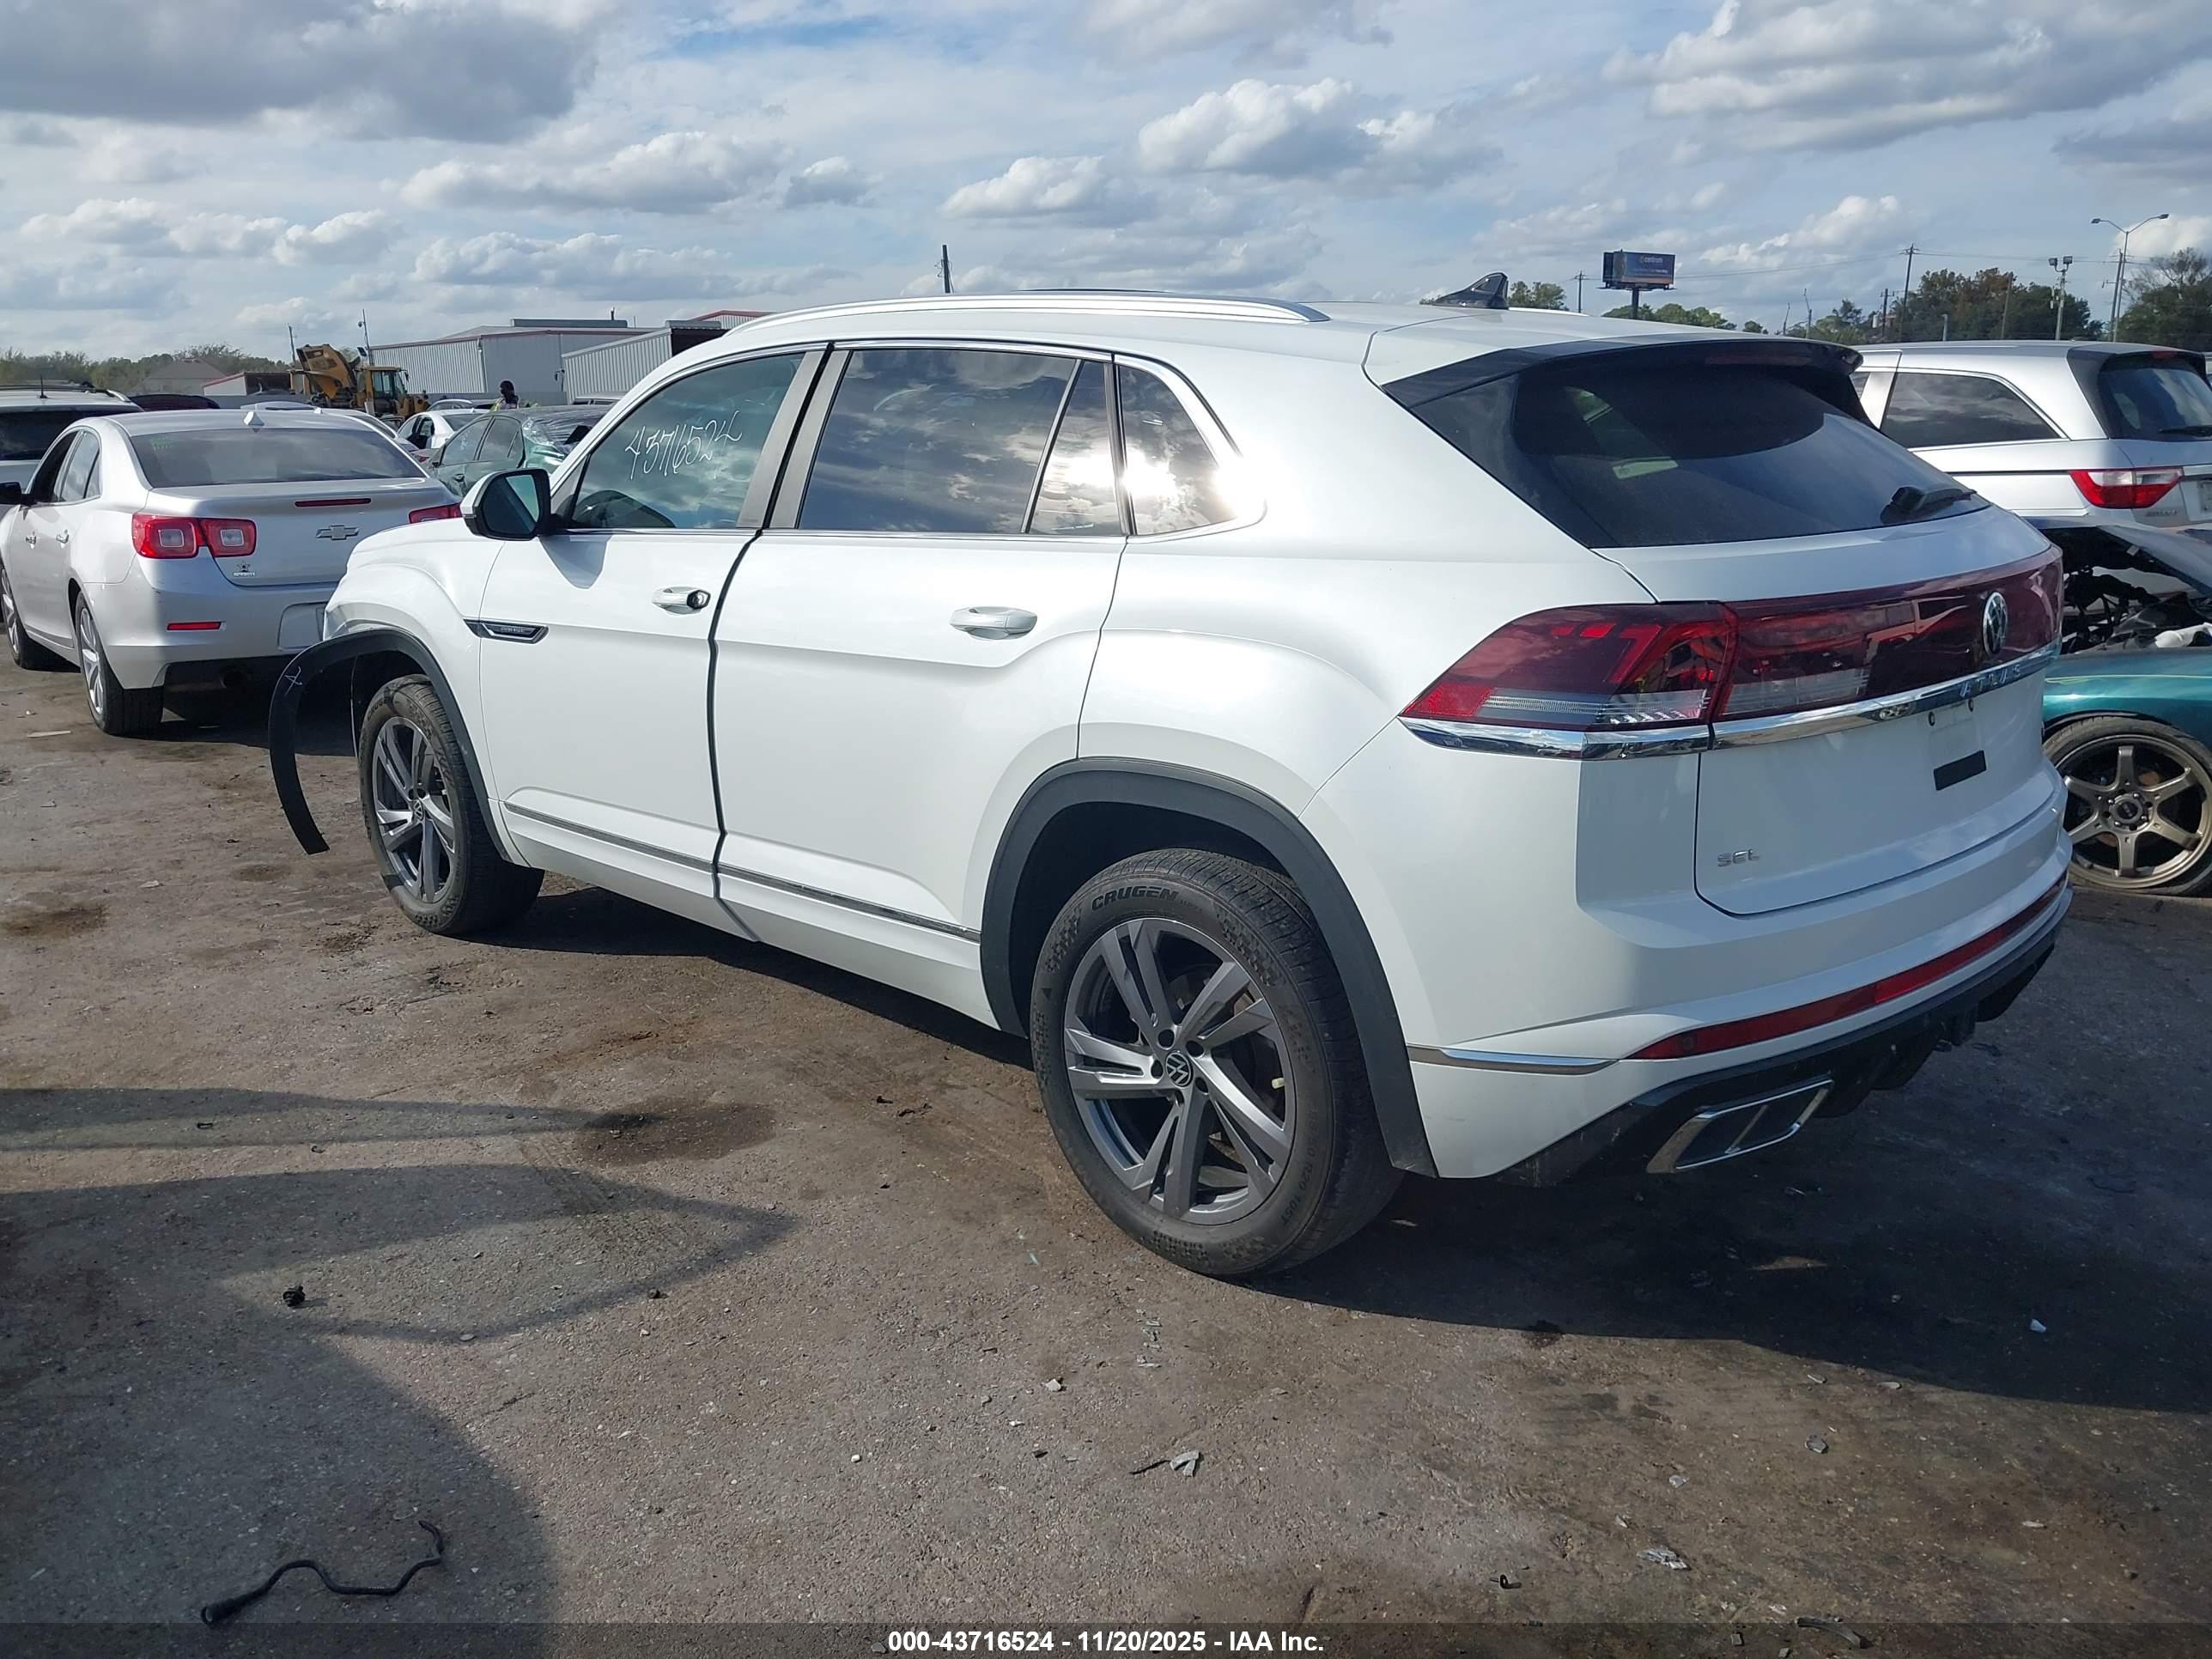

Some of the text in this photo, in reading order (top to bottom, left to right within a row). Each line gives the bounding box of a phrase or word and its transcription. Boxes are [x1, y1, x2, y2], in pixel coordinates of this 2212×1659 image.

[624, 410, 743, 480] 43716524
[1717, 849, 1759, 866] SEL
[1091, 885, 1179, 910] CRUGEN
